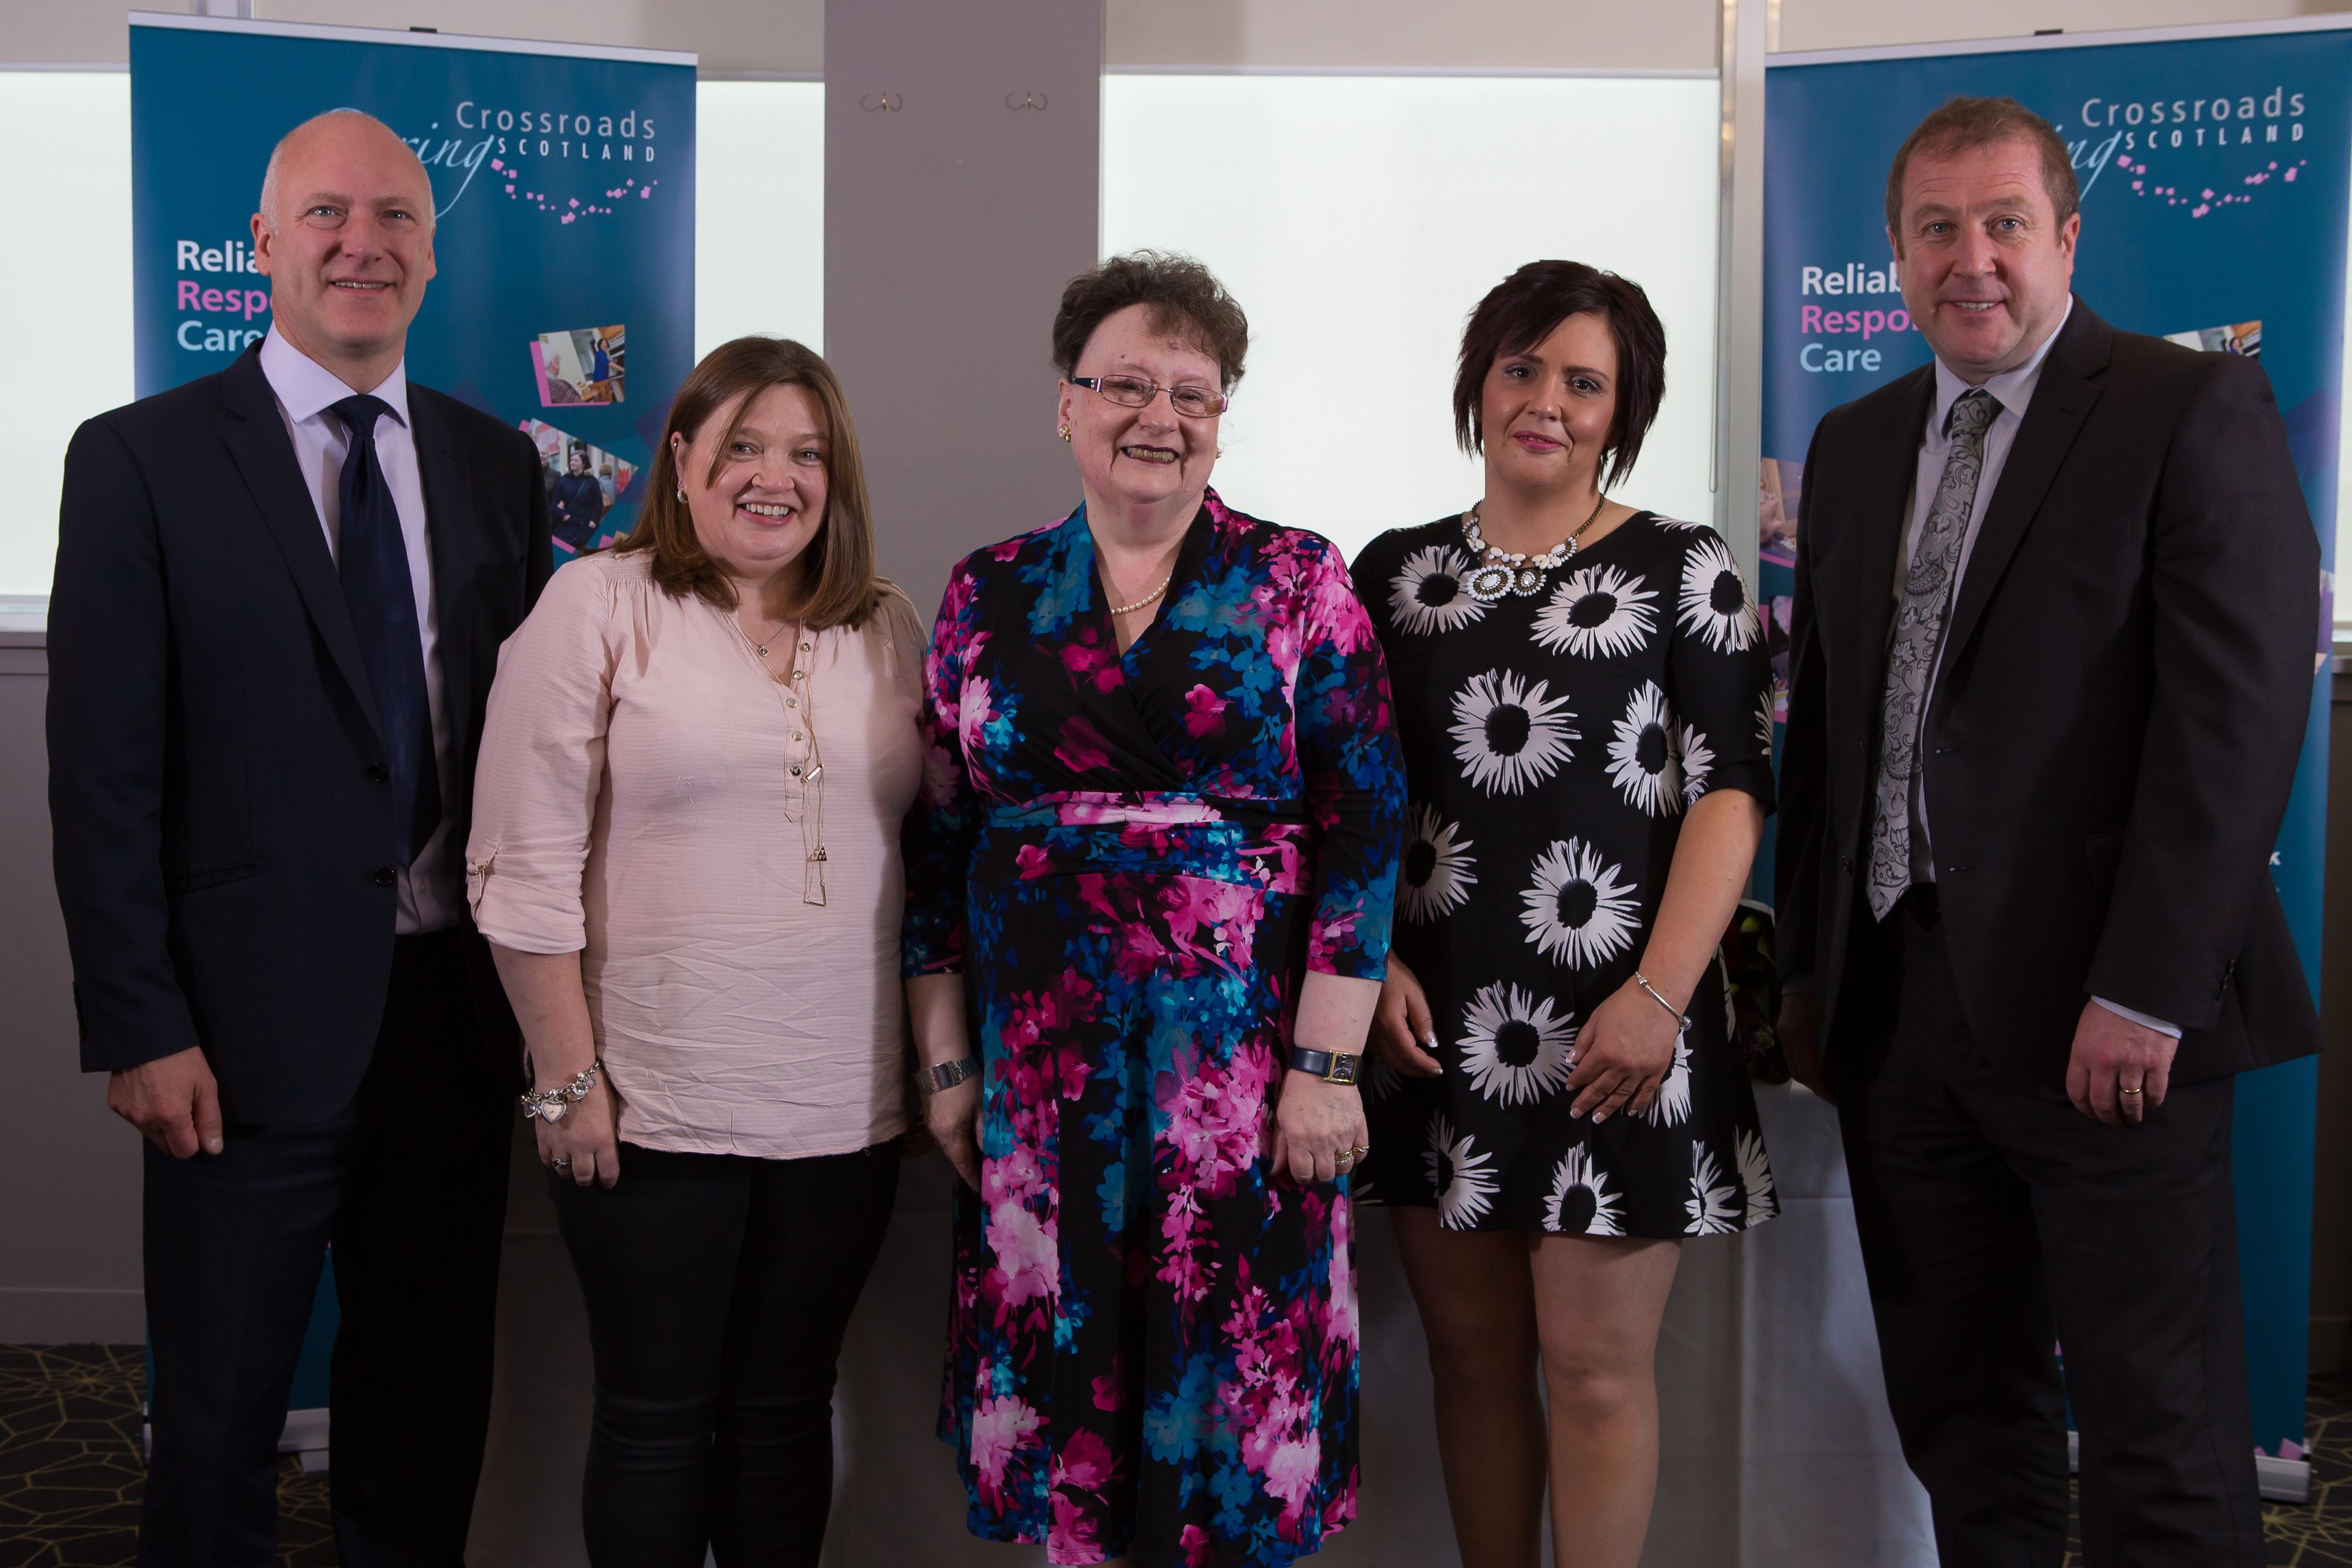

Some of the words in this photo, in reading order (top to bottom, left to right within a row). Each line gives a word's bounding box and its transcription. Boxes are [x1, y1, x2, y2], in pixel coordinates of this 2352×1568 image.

[456, 101, 655, 139] Crossroads
[2082, 86, 2305, 127] Crossroads
[498, 137, 656, 163] SCOTLAND
[2126, 123, 2304, 150] SCOTLAND
[1802, 261, 1901, 295] Reliab
[177, 280, 272, 321] Resp
[1801, 305, 1919, 340] Respo
[1800, 343, 1882, 372] Care
